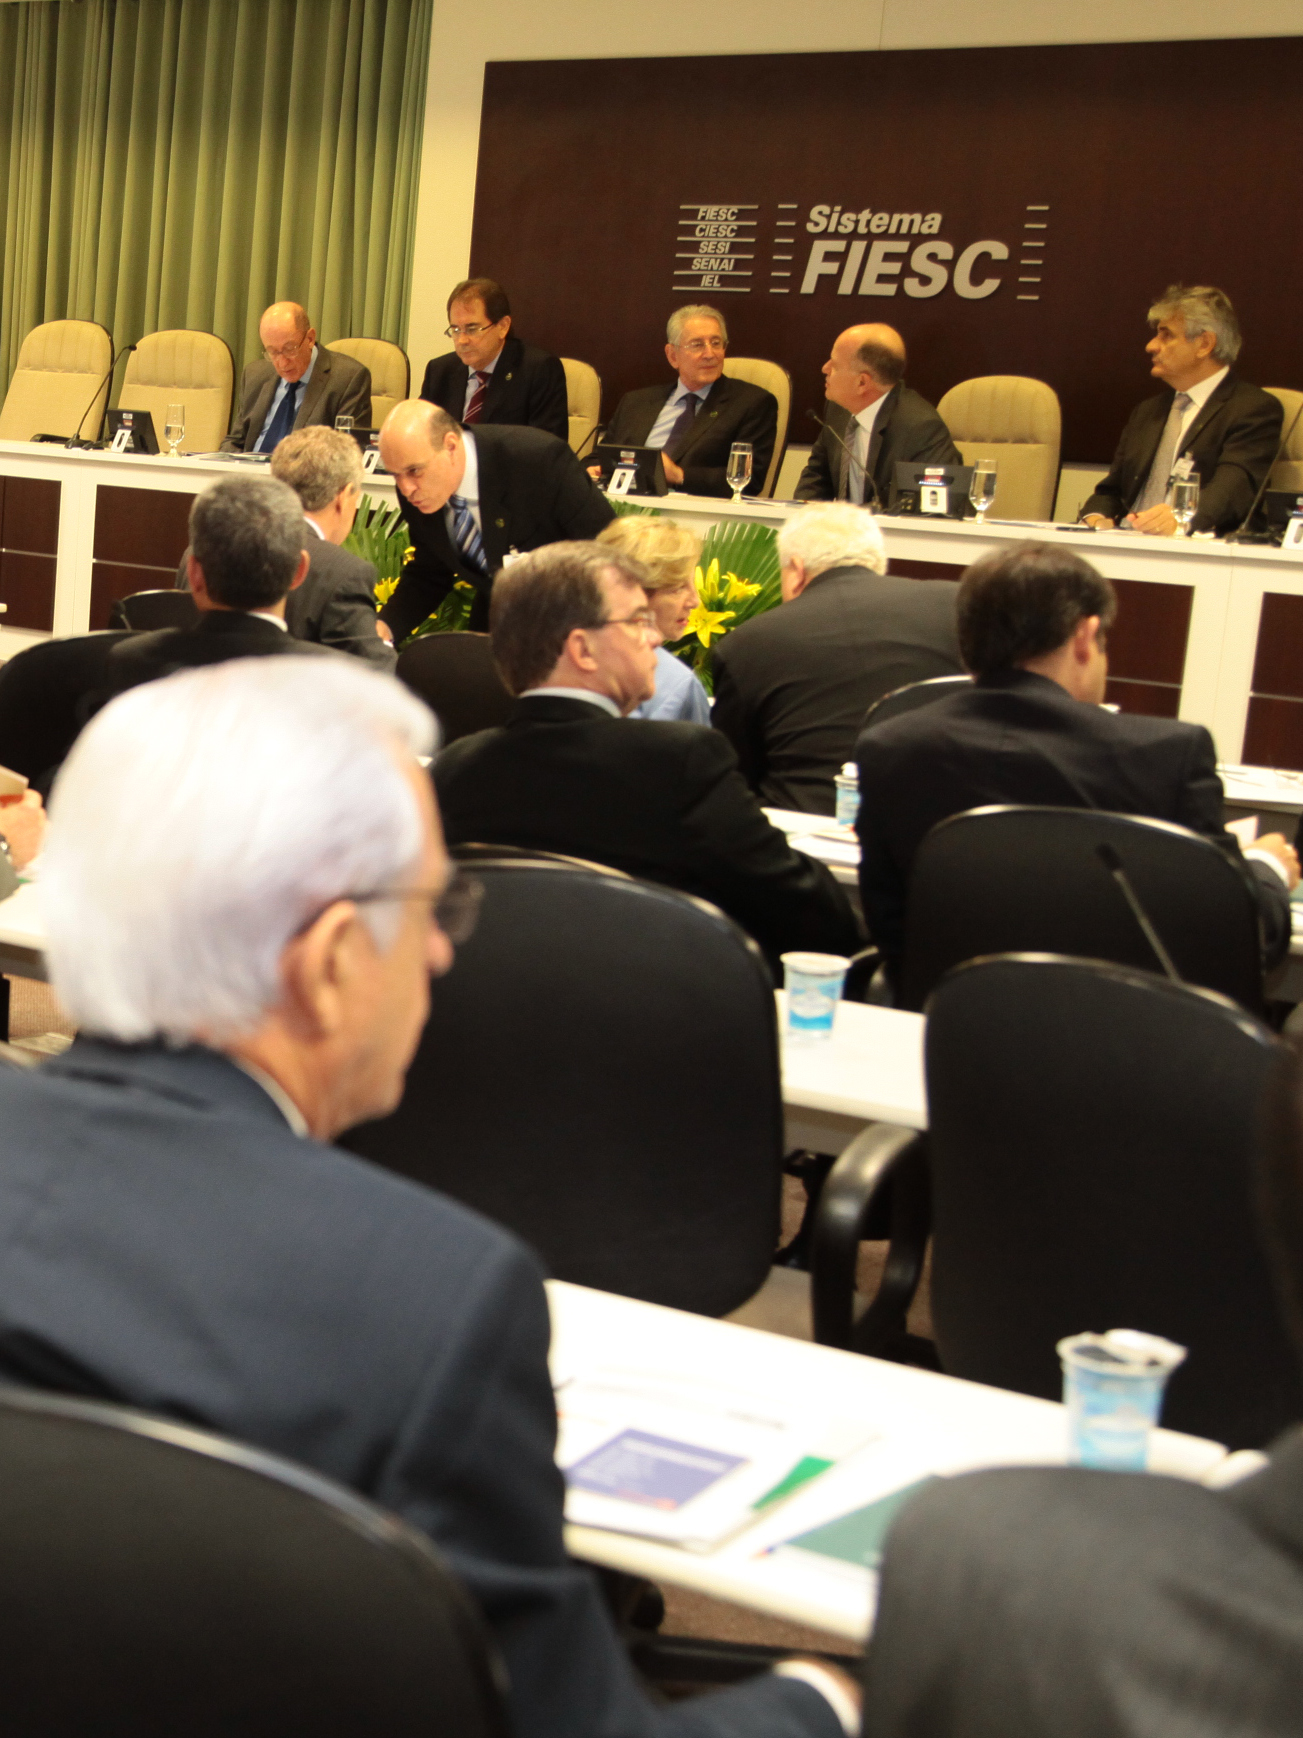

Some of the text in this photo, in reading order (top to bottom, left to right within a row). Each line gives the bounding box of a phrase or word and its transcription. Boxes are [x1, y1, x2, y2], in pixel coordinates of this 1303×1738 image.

[696, 207, 739, 221] FIESC
[805, 204, 943, 235] Sistema
[694, 224, 738, 238] CIESC
[698, 241, 731, 254] SESI
[691, 257, 735, 271] SENAI
[799, 240, 1010, 300] FIESC
[700, 274, 722, 288] IEL
